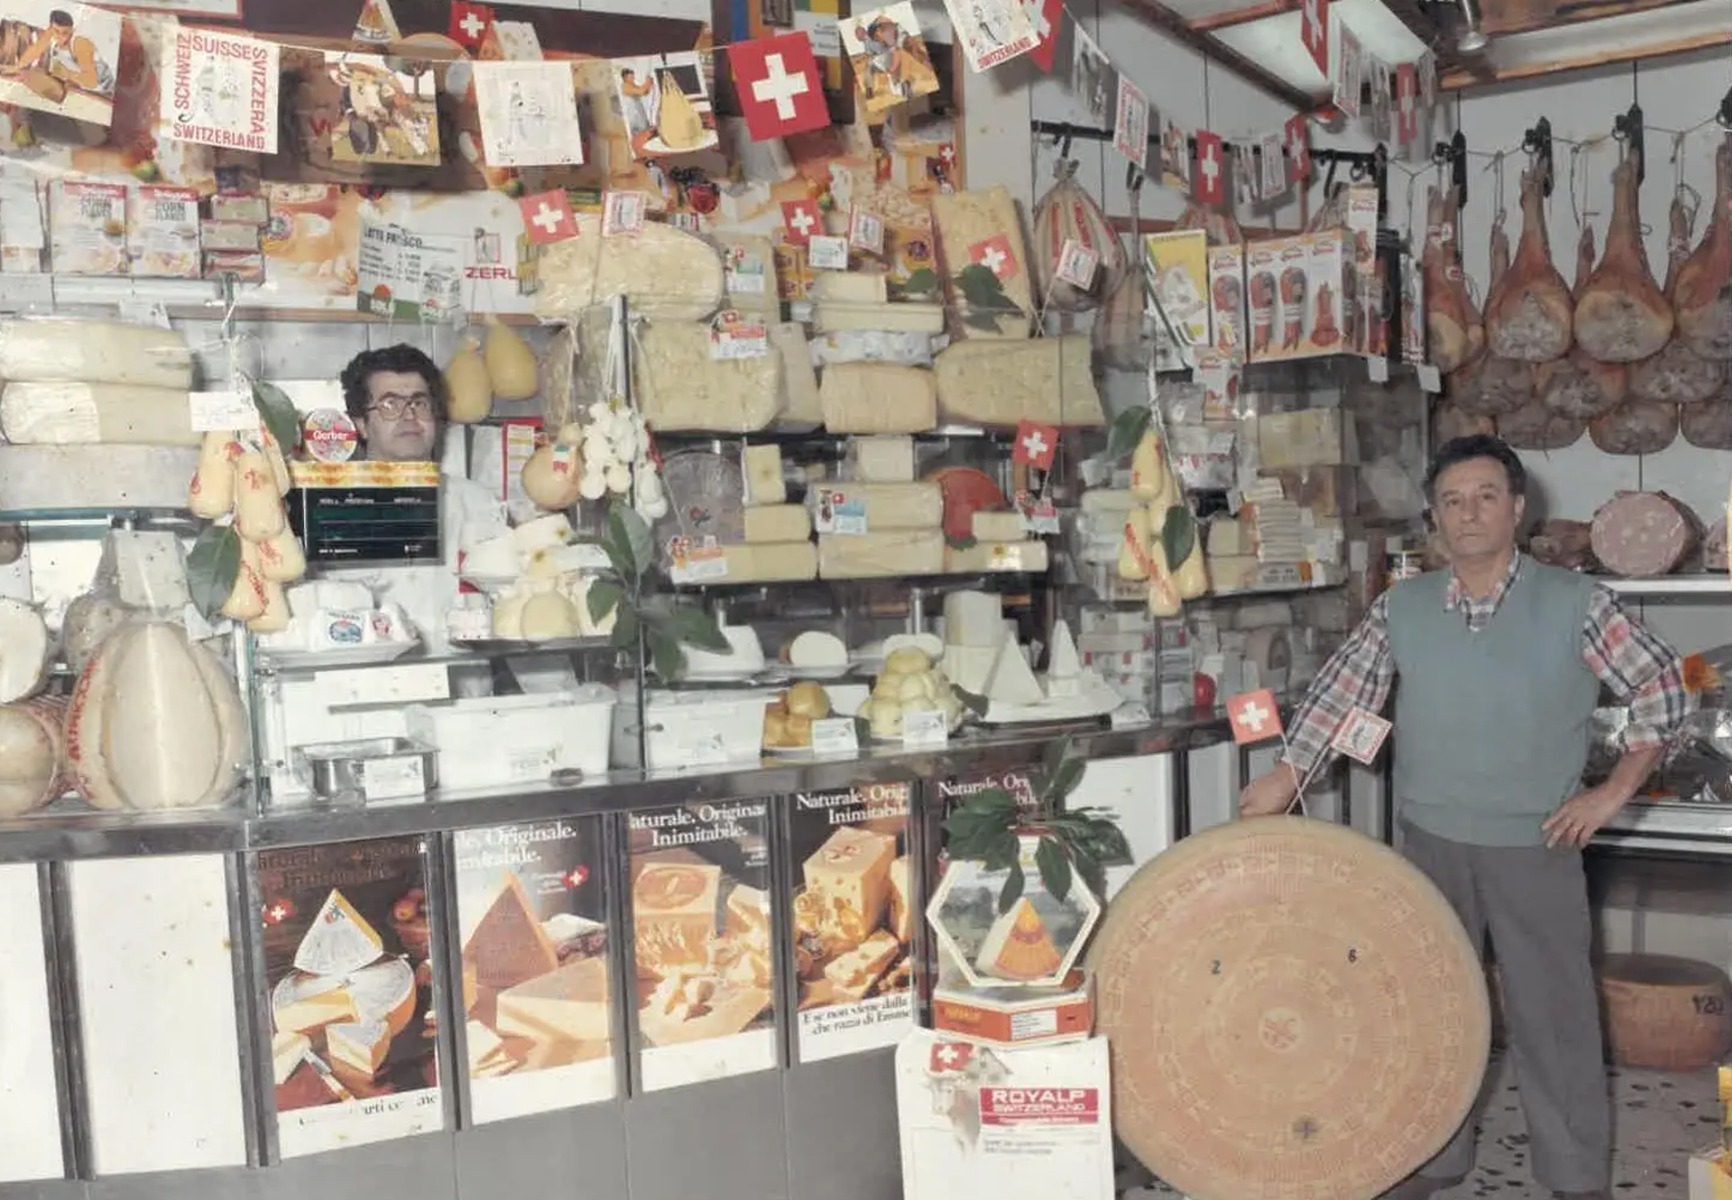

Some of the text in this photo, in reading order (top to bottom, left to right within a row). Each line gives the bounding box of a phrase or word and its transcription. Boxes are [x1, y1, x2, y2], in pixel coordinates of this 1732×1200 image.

[192, 36, 252, 60] SUISSE
[174, 33, 191, 110] SCHWEIZ
[250, 46, 267, 134] SVIZZERA
[173, 122, 265, 149] SWITZERLAND
[313, 429, 348, 441] Gerber
[796, 787, 867, 811] Naturale.
[651, 821, 748, 847] Inimitabile.
[1211, 959, 1221, 975] 2
[991, 1090, 1086, 1103] ROYALP
[993, 1103, 1086, 1114] SWITZERLAND
